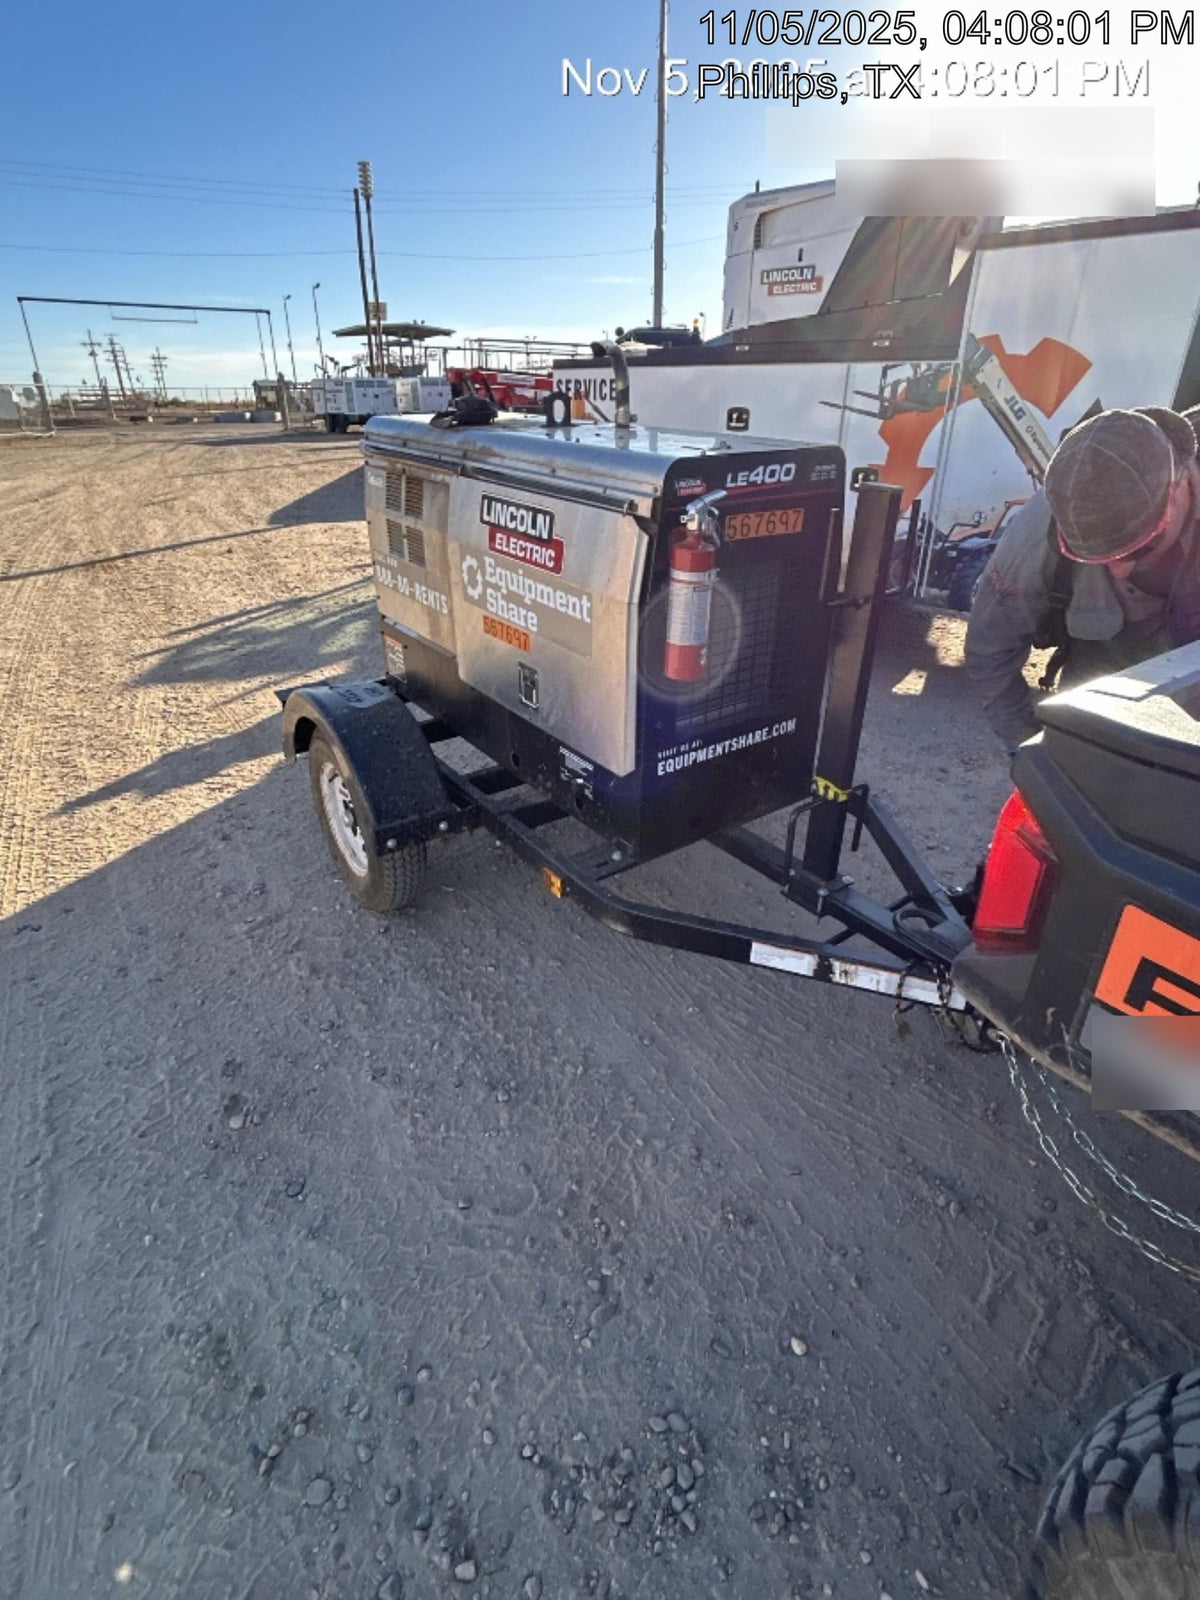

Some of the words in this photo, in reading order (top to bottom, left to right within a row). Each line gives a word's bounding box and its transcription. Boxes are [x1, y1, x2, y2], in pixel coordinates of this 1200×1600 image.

[762, 267, 814, 284] LINCOLN
[772, 282, 818, 295] ELECTRIC
[556, 378, 617, 401] SERVICE
[1003, 395, 1027, 422] JLG
[726, 462, 796, 489] LE400
[482, 498, 551, 541] LINCOLN
[727, 509, 804, 541] 567697
[495, 532, 556, 568] ELECTRIC
[484, 555, 592, 624] Equipment
[486, 587, 539, 633] Share
[656, 717, 797, 776] EQUIPMENTSHARE.COM
